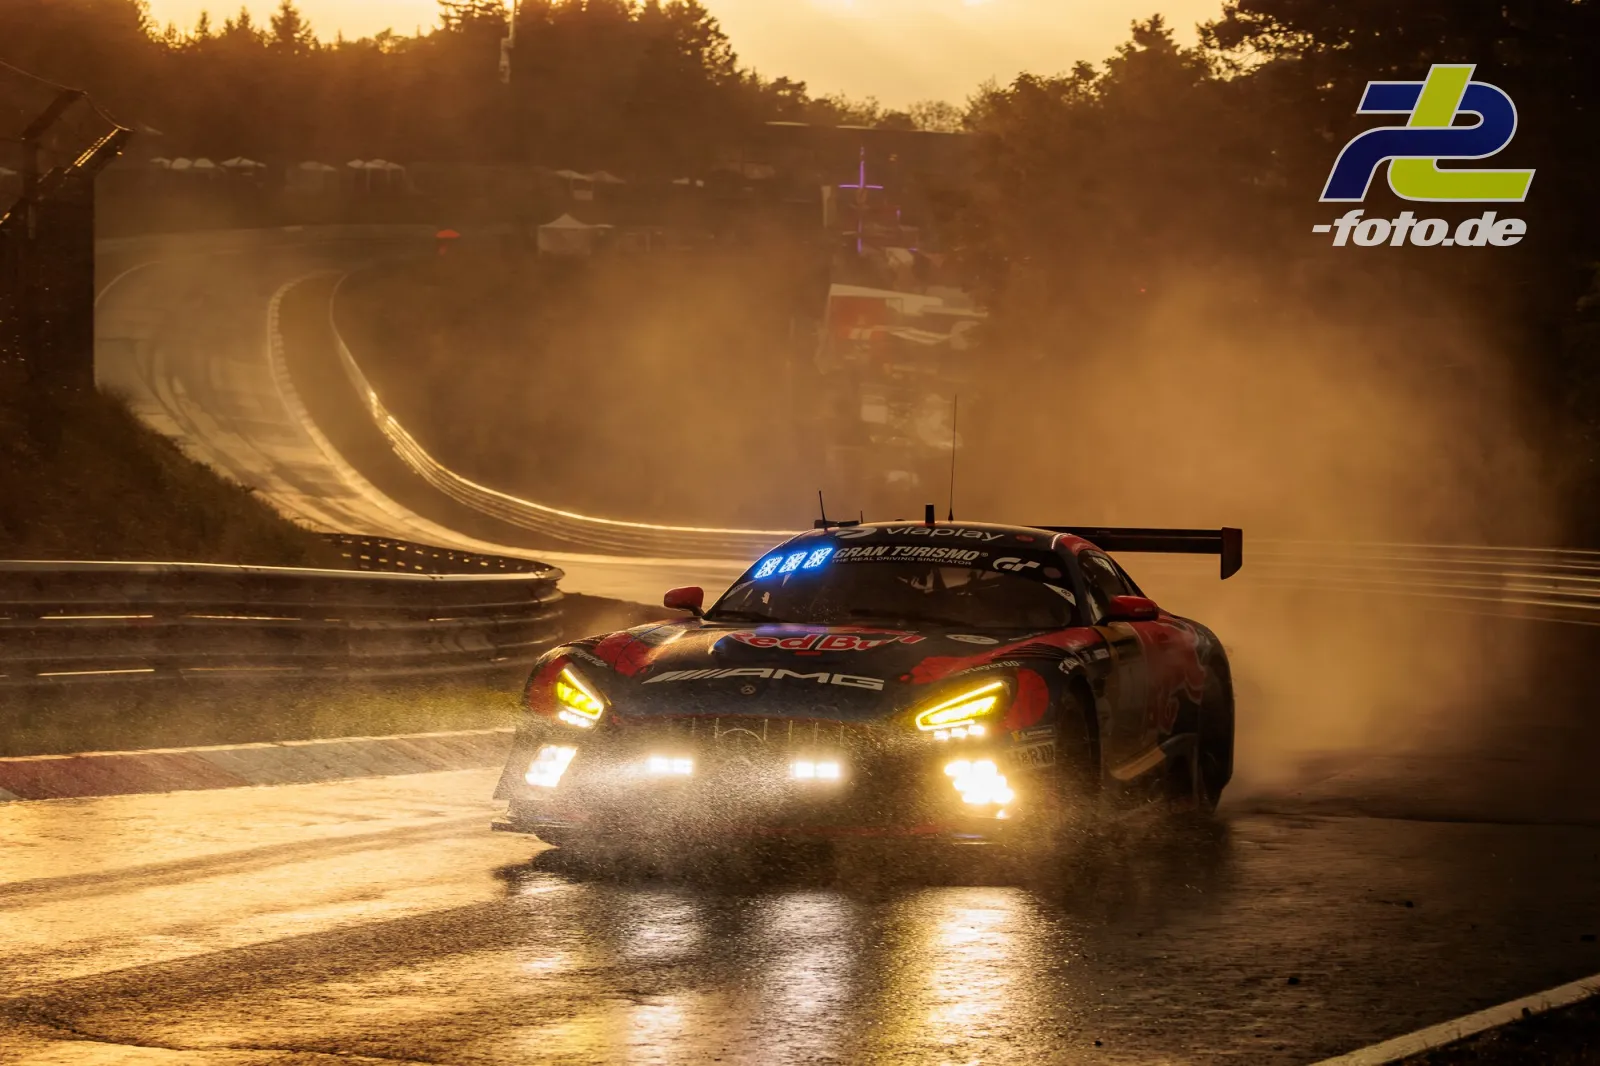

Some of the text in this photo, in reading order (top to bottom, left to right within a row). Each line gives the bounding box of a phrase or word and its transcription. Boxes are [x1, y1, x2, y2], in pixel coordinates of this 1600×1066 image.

[886, 526, 1006, 542] viaplay
[833, 546, 890, 559] GRAN
[917, 556, 972, 566] SIMULATOR
[729, 632, 823, 651] Red
